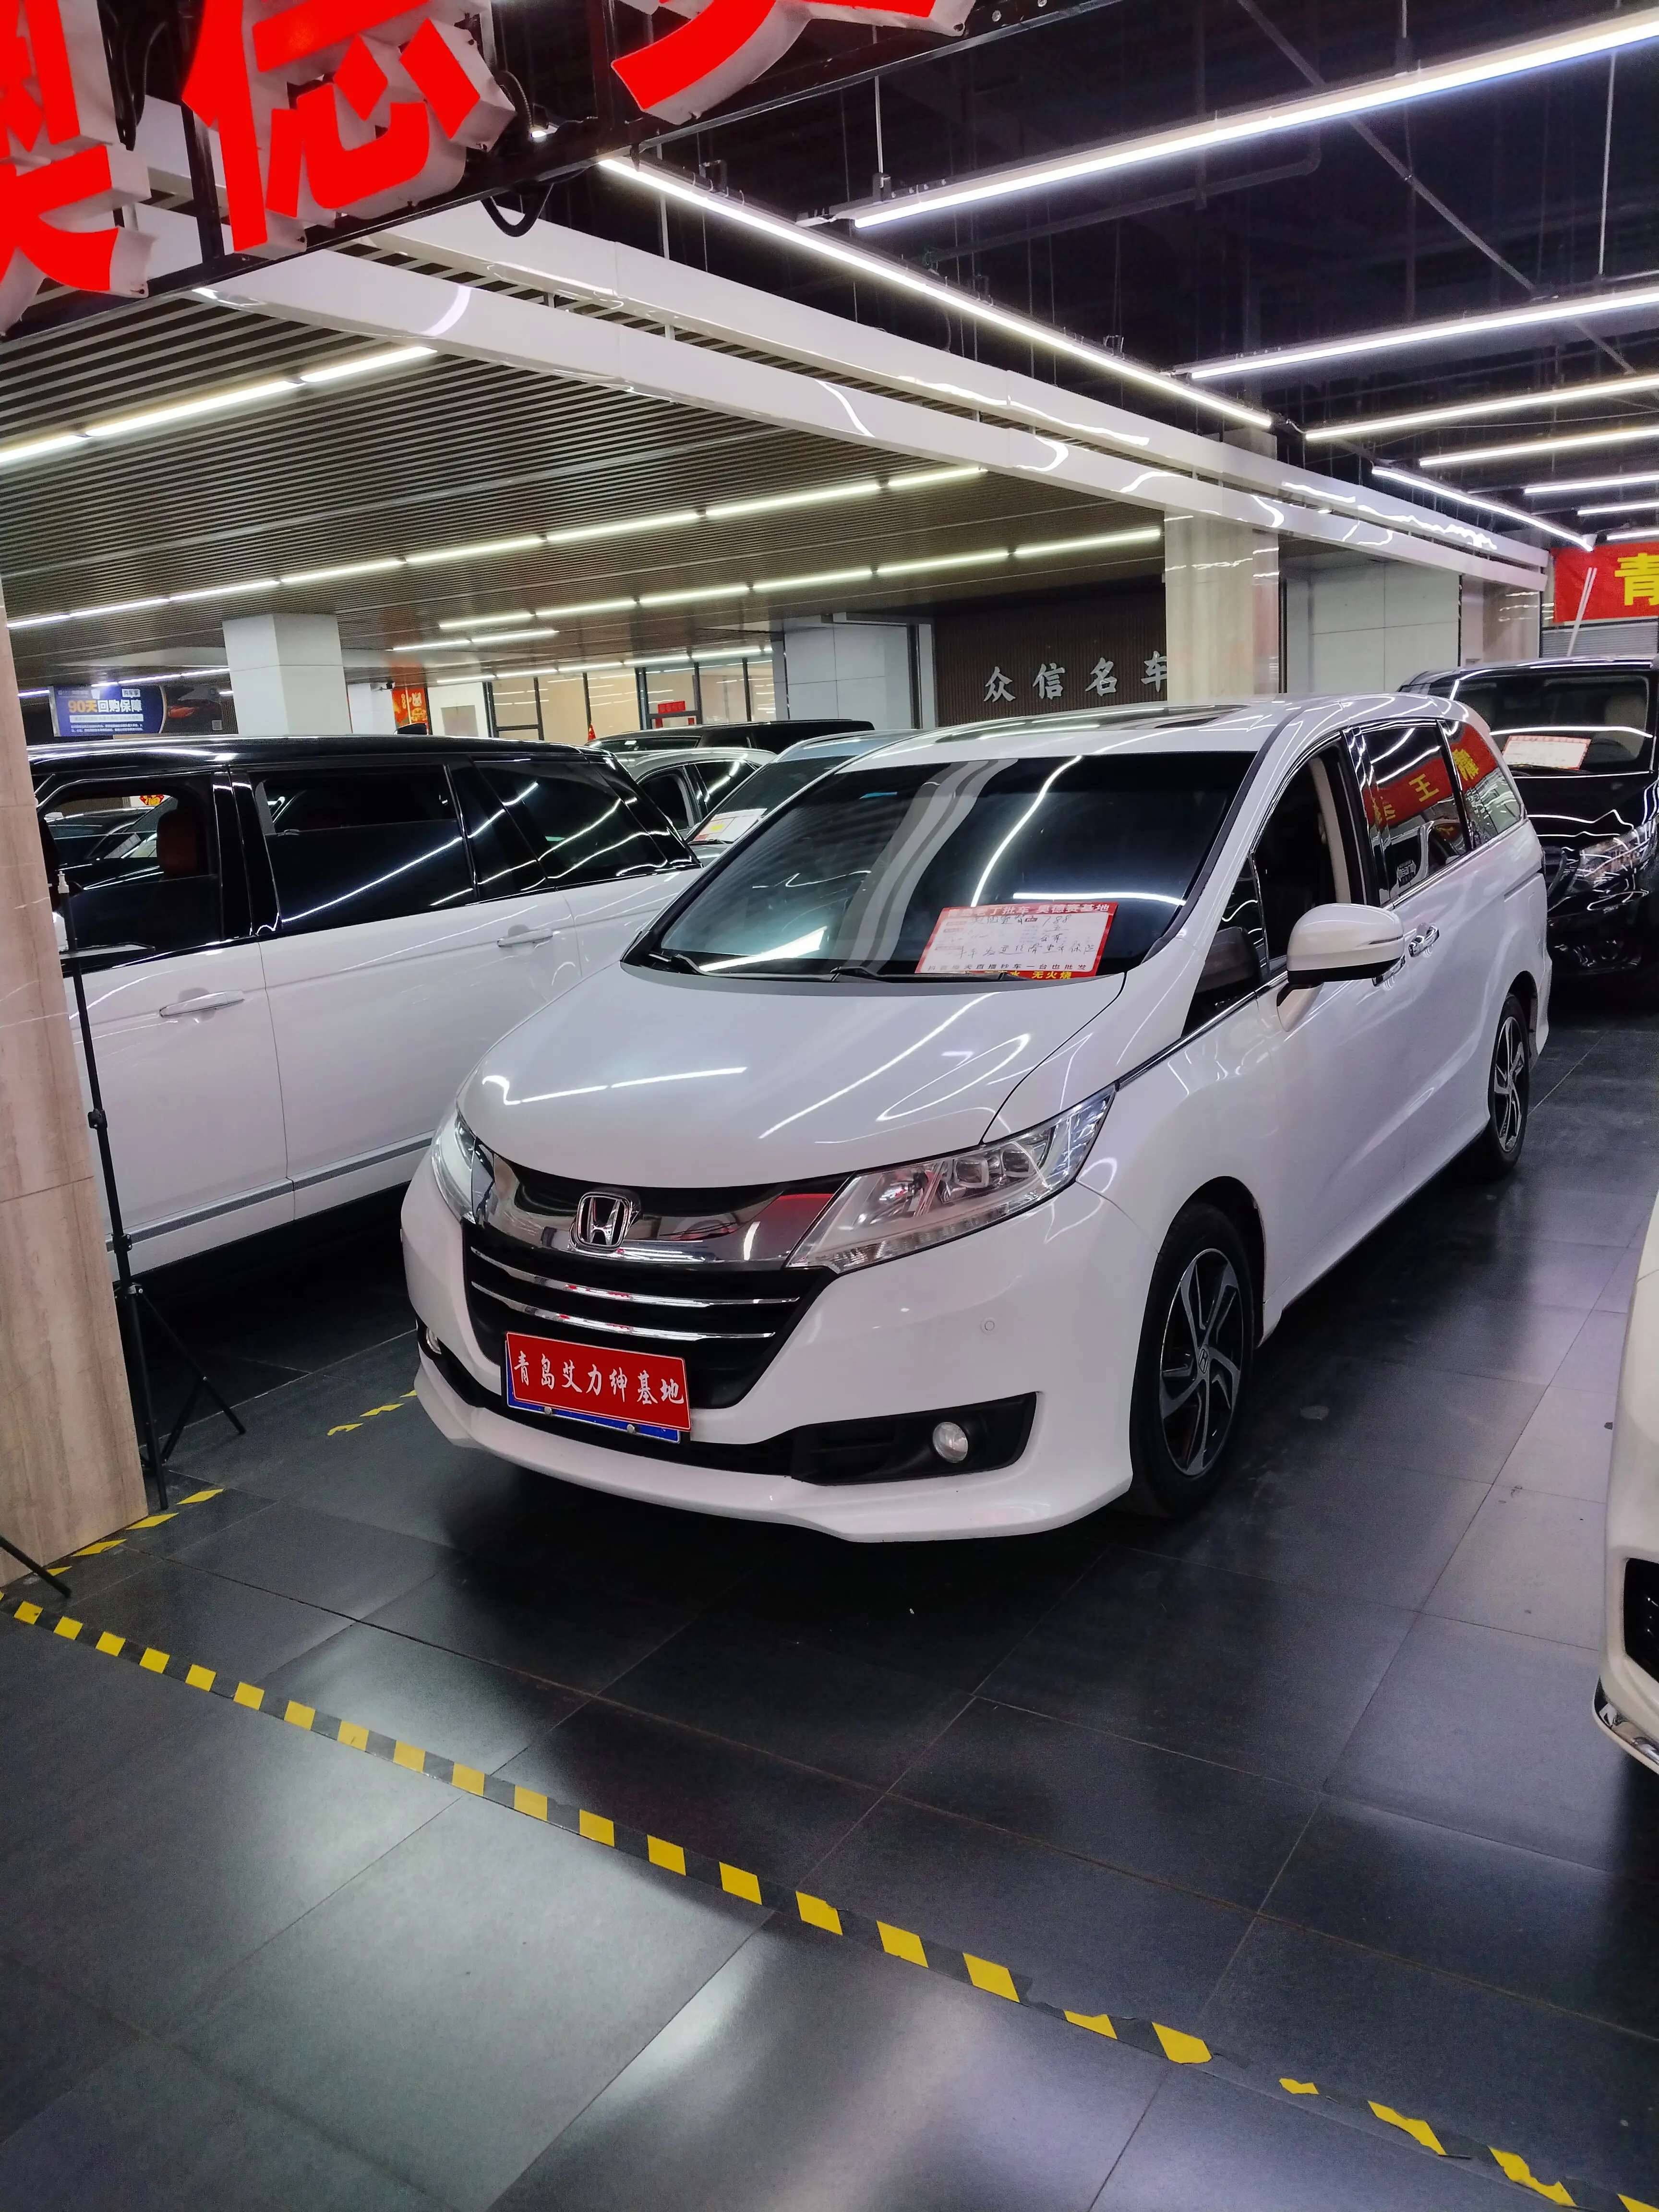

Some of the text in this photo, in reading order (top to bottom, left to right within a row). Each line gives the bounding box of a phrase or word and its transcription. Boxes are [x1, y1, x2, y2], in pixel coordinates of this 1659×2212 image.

[983, 650, 1167, 702] 众信名车
[68, 699, 142, 713] 90天回购保障
[514, 1350, 685, 1406] 青岛艾力绅基地
